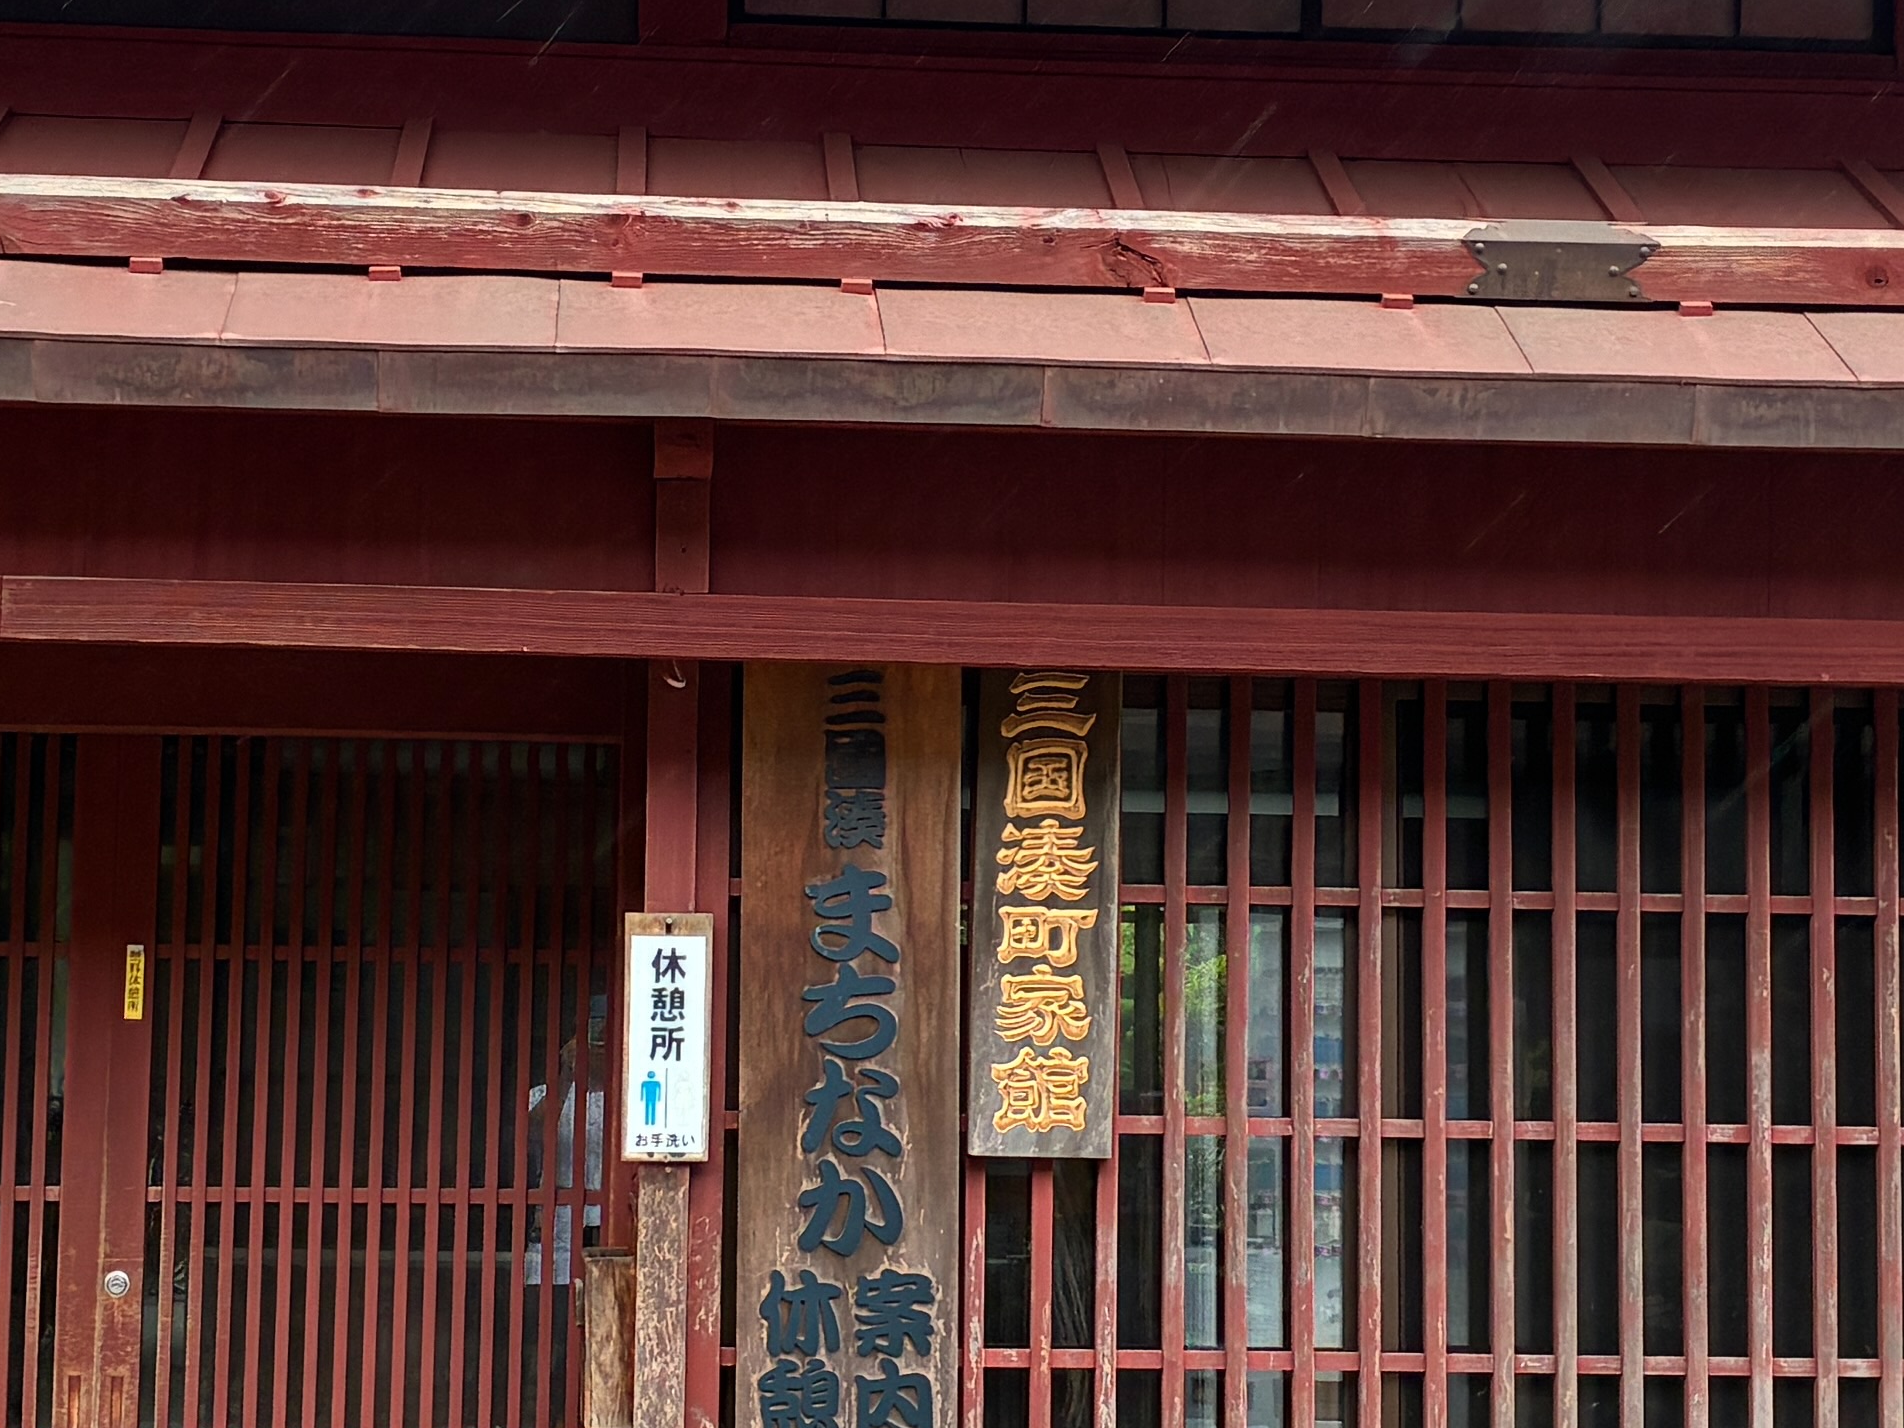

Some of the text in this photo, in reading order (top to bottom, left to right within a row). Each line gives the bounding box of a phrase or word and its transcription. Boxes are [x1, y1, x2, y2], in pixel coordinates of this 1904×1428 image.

[649, 947, 687, 1062] 休憩所
[797, 864, 904, 1255] まちなか
[635, 1133, 695, 1148] お手洗い
